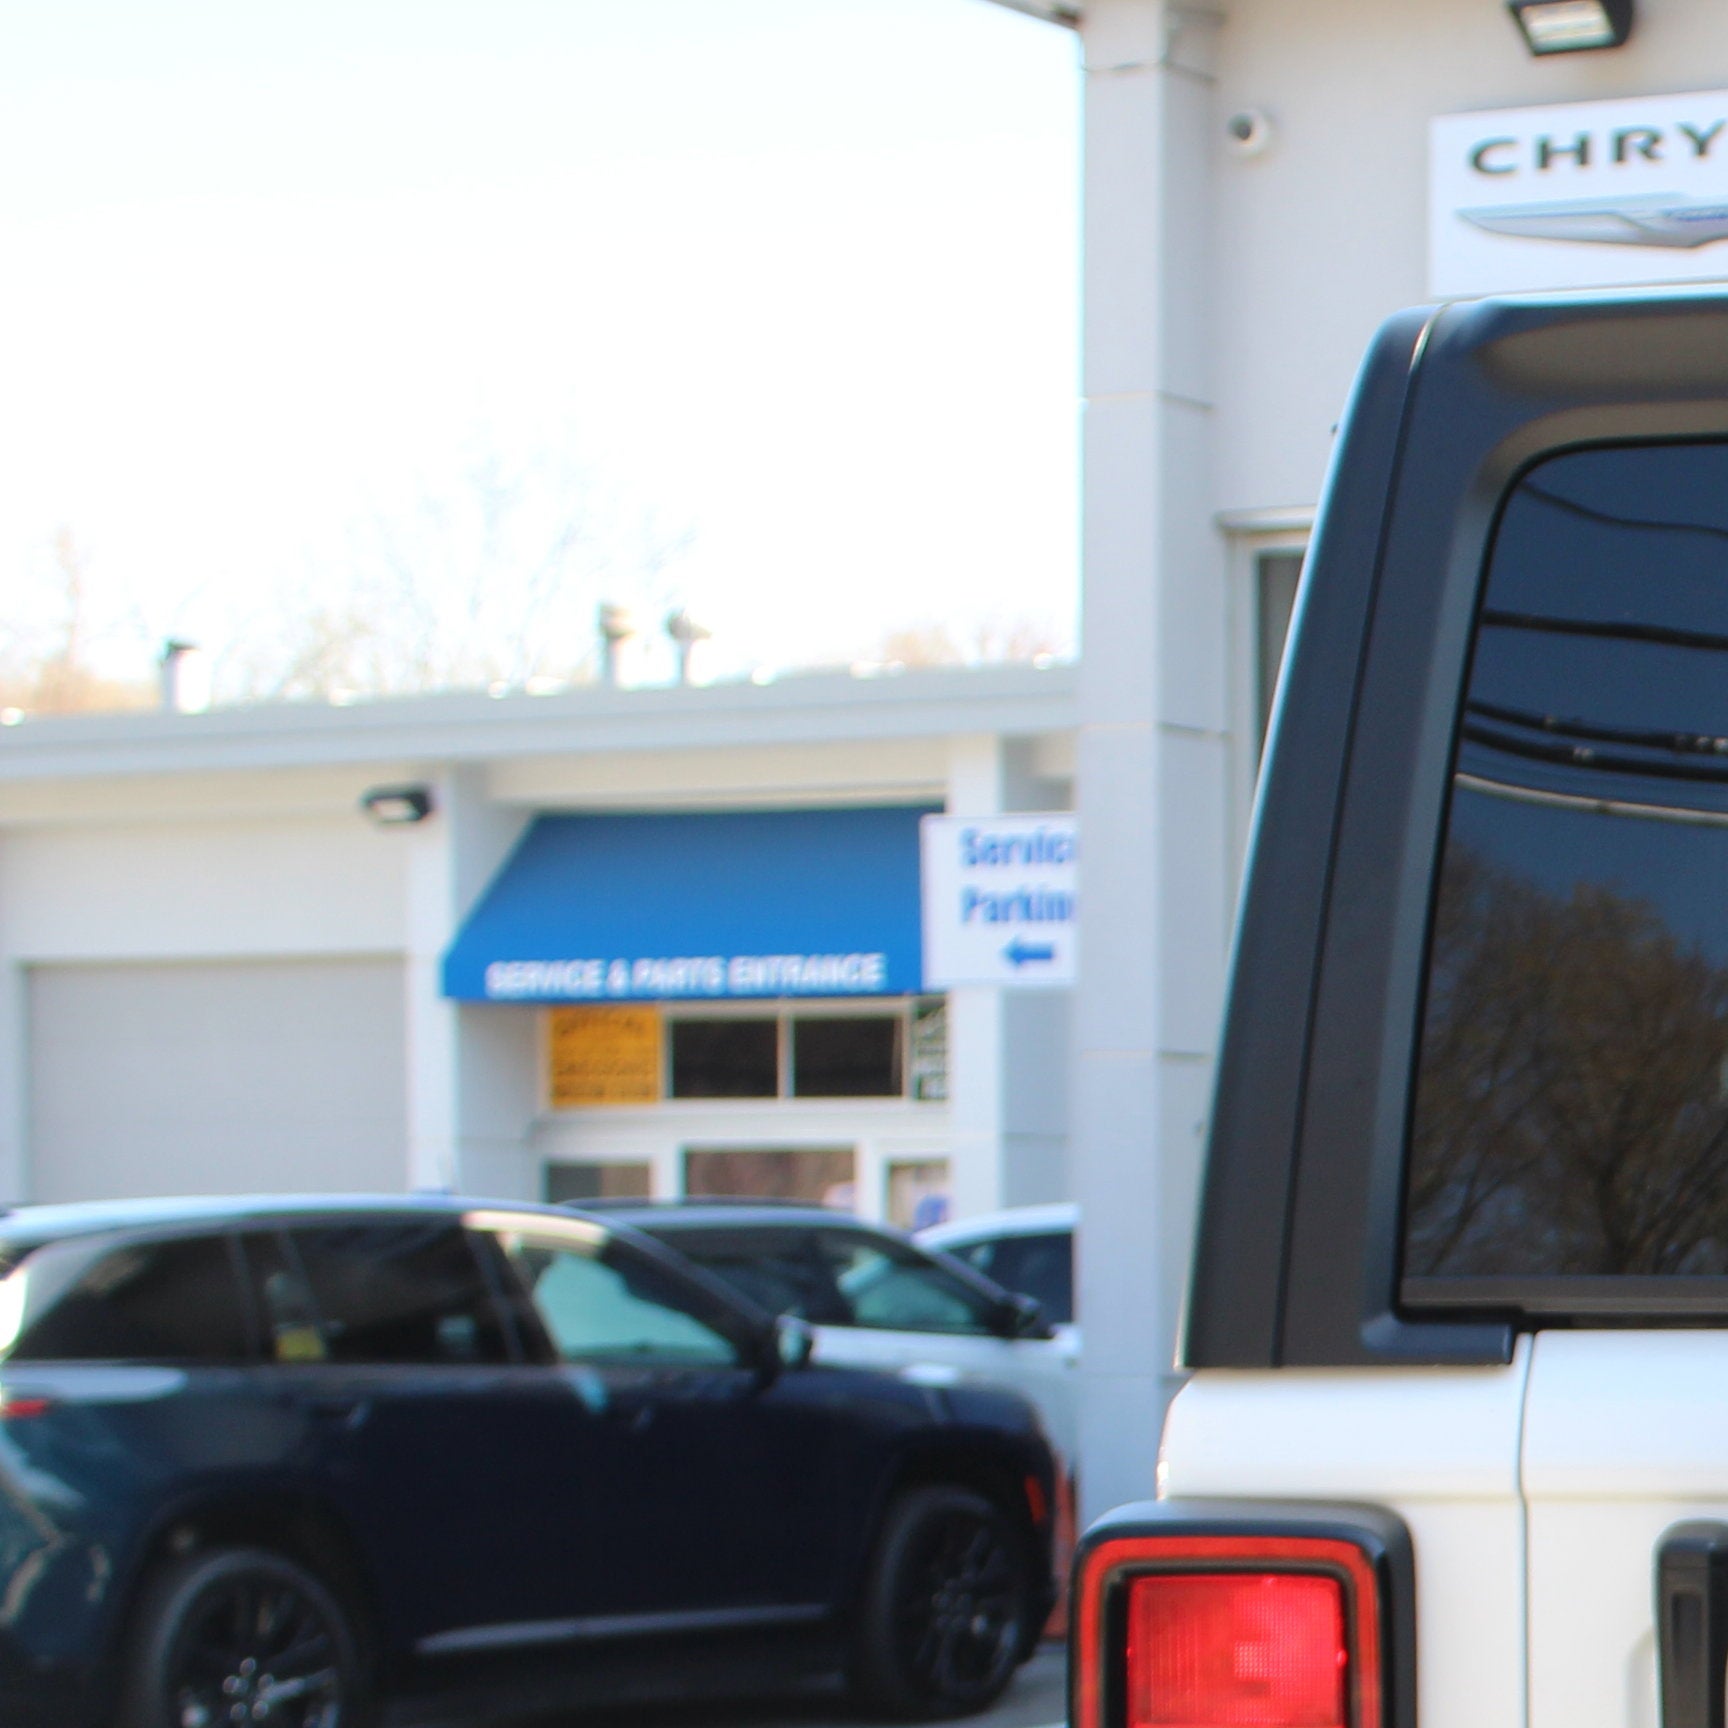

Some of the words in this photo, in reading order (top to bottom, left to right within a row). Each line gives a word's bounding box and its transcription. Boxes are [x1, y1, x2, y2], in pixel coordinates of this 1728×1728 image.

[960, 826, 1078, 865] Servic
[960, 885, 1078, 926] Parkin
[485, 960, 605, 999] SERVICE
[631, 956, 726, 997] PARTS
[728, 952, 887, 994] ENTRANCE
